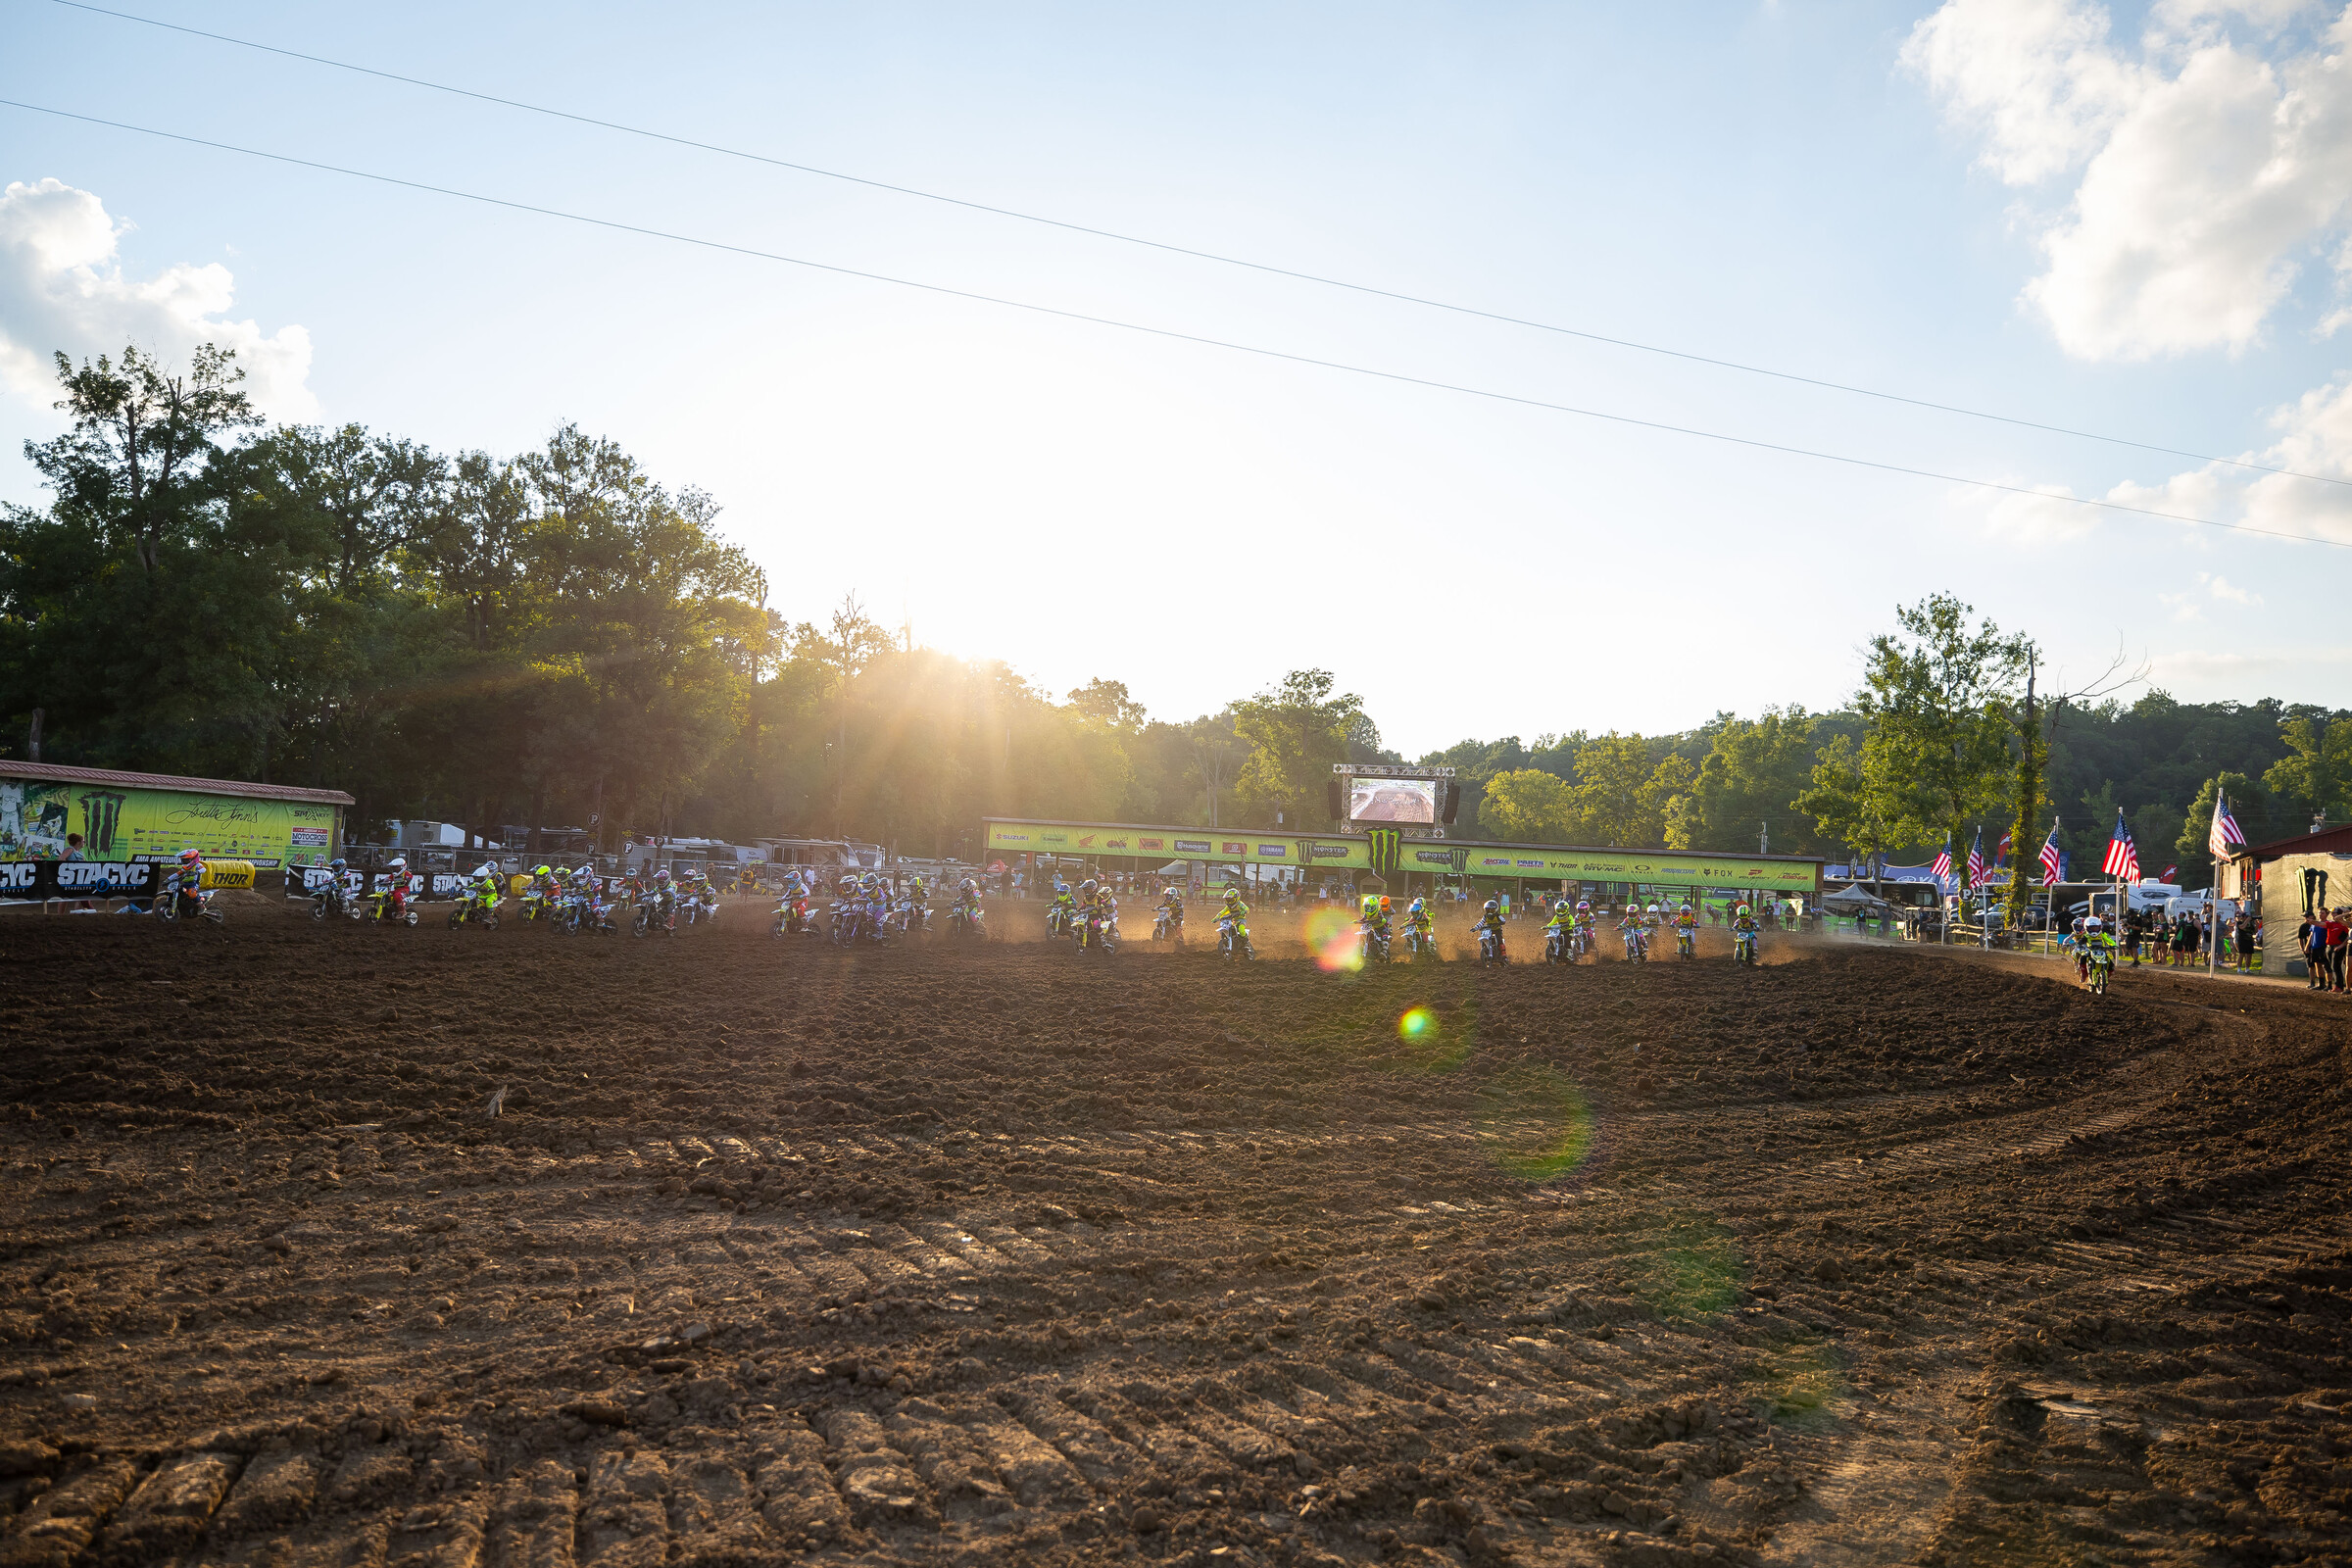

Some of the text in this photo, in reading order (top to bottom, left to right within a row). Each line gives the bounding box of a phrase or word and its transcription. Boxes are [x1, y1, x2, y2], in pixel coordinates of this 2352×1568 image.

[57, 862, 150, 885] STACYC
[214, 872, 249, 885] THOR
[1962, 888, 1972, 900] P
